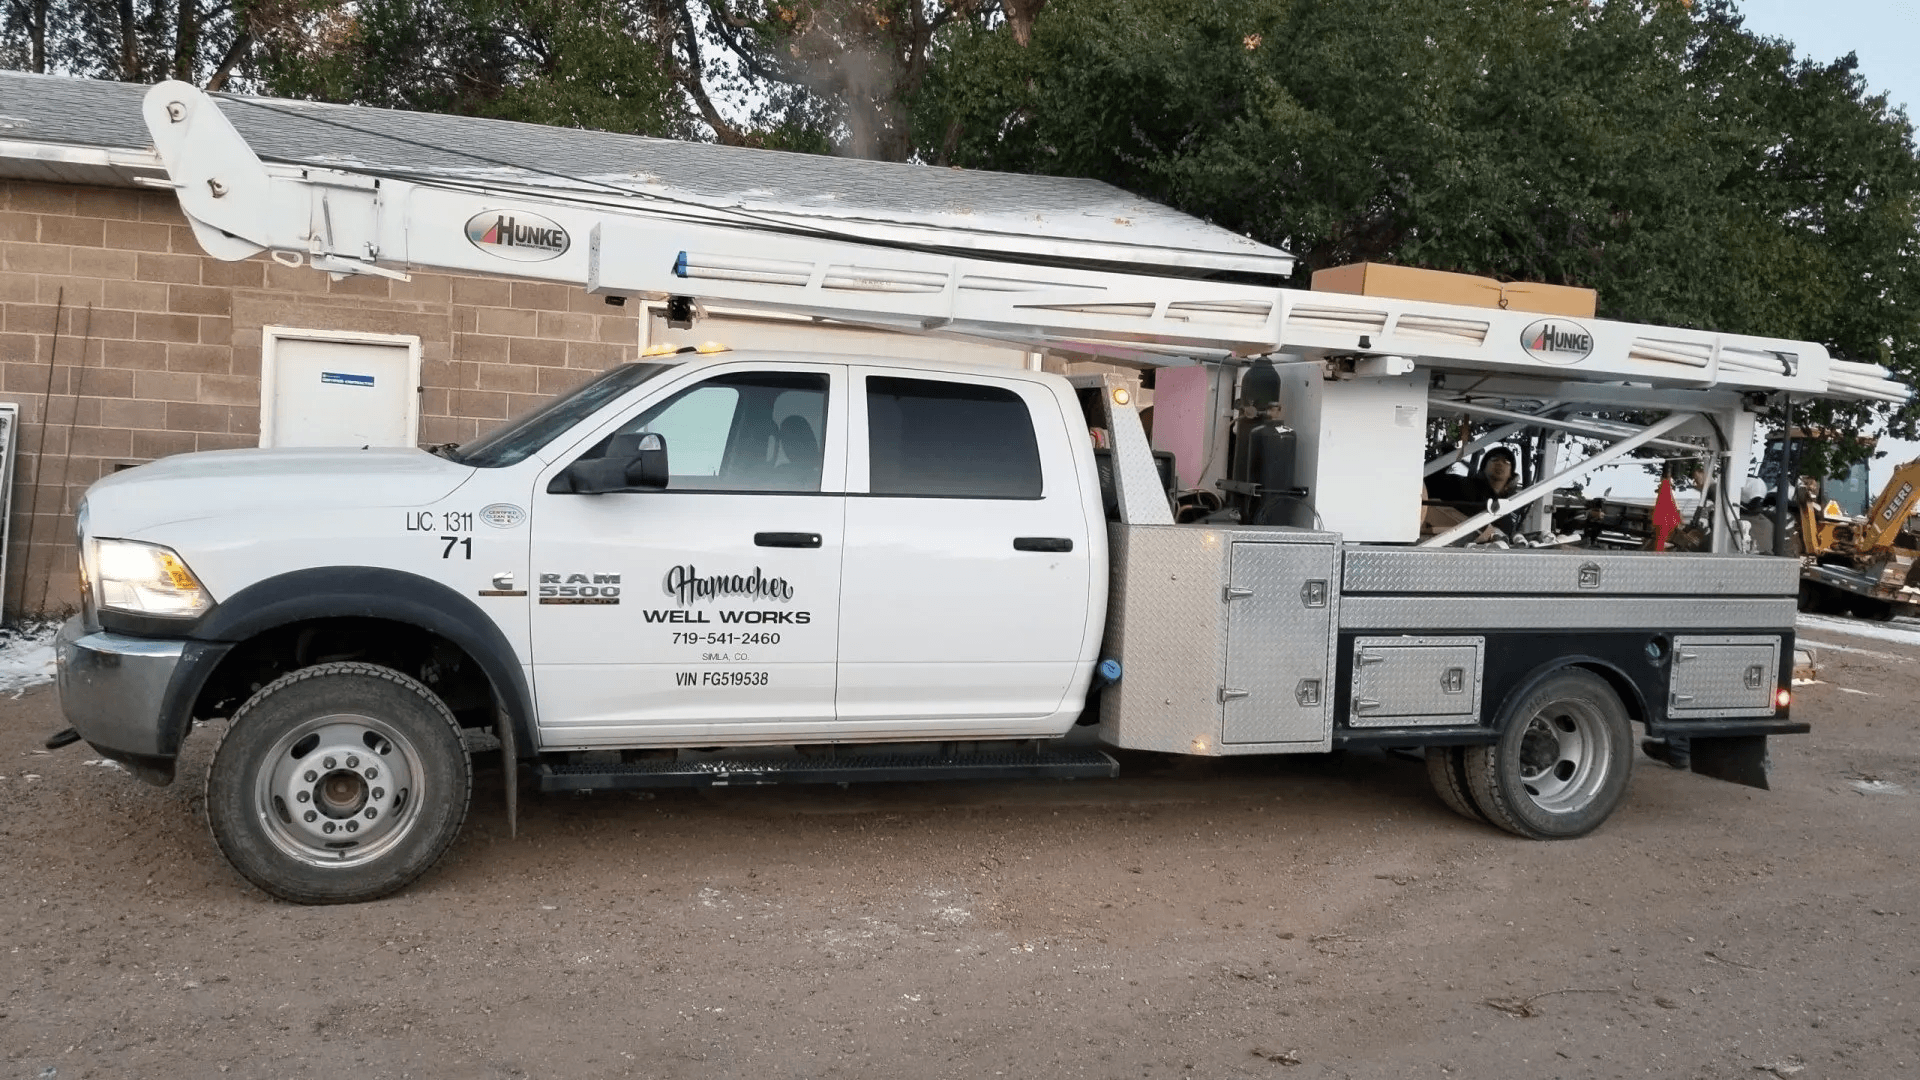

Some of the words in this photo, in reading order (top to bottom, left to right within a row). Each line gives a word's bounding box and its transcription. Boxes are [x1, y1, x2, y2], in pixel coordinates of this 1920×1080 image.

[496, 214, 563, 248] HUNKE
[1542, 324, 1589, 351] HUNKE
[1883, 482, 1912, 520] DEERE
[406, 511, 436, 531] LIC.
[442, 511, 473, 531] 1311
[440, 536, 472, 560] 71
[539, 572, 620, 584] RAM
[663, 563, 794, 607] Hamacher
[539, 586, 620, 597] 5500
[642, 610, 711, 624] WELL
[718, 610, 812, 625] WORKS
[672, 632, 781, 645] 719-541-2460
[702, 652, 731, 662] SIMLA,
[734, 652, 750, 661] CO.
[676, 671, 698, 687] VIN
[702, 671, 769, 687] FG519538
